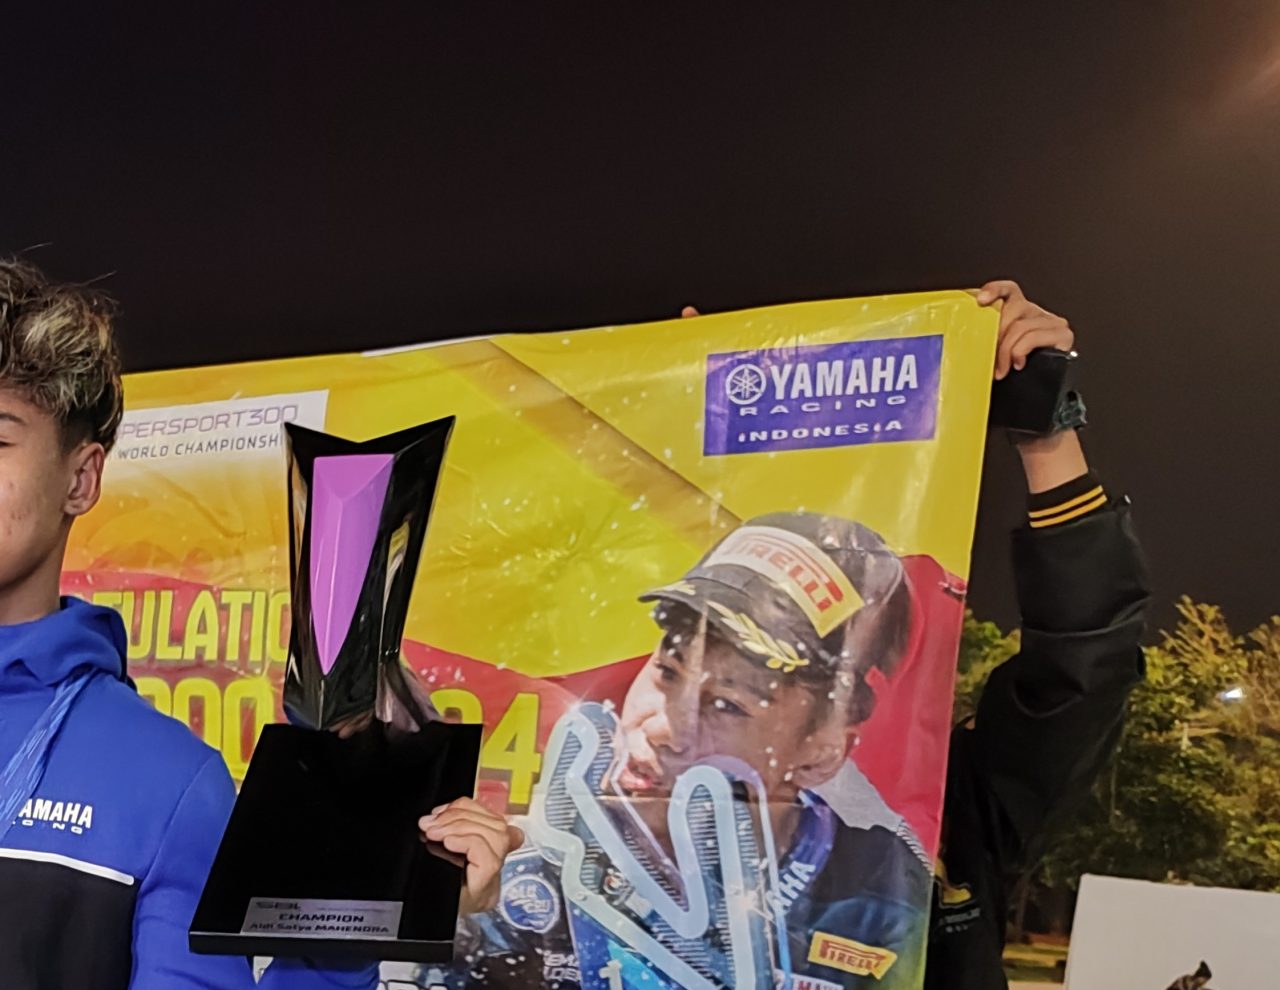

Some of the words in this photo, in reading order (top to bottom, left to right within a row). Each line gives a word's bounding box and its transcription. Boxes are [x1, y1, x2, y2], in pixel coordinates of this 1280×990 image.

[770, 353, 918, 400] YAMAHA
[739, 394, 906, 417] RACING
[738, 419, 903, 442] INDONESIA
[118, 446, 169, 460] WORLD
[279, 913, 365, 923] CHAMPION
[314, 924, 390, 933] MAHENDRA
